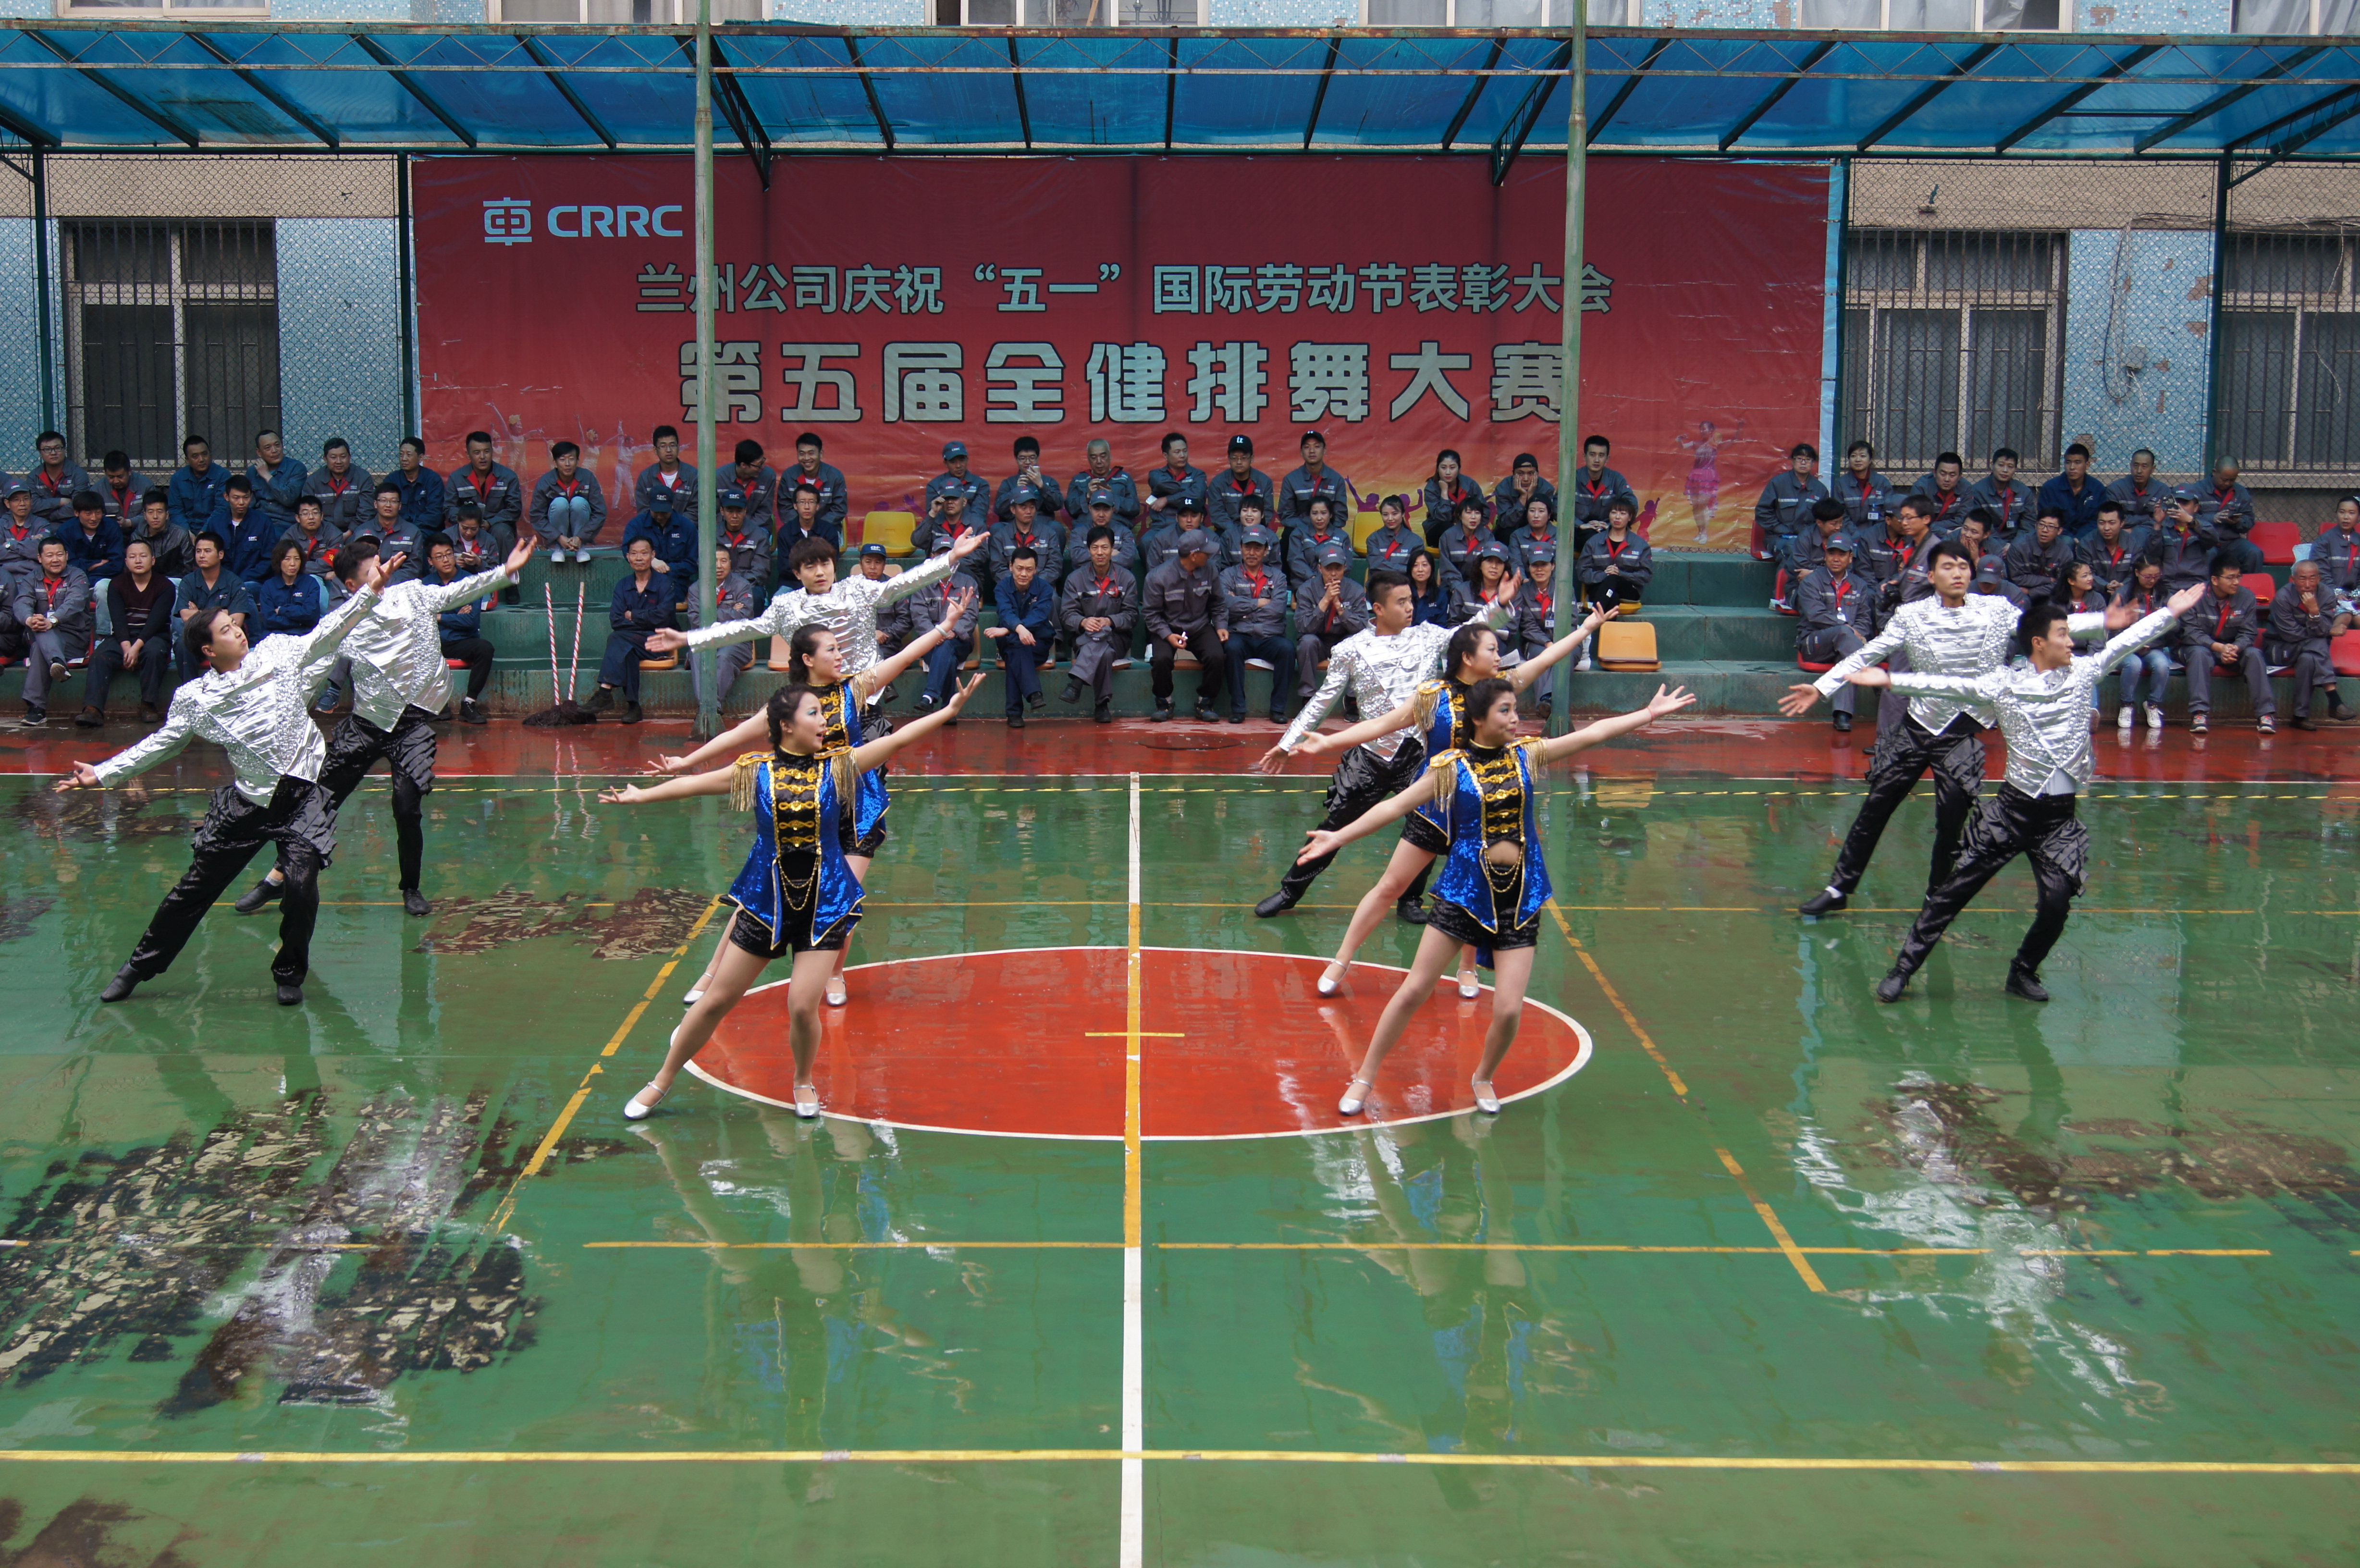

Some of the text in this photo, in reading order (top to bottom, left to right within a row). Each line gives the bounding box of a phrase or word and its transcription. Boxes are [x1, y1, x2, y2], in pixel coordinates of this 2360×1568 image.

[548, 205, 683, 237] CRRC
[637, 263, 944, 314] 兰州公司庆祝
[1154, 262, 1614, 314] 国际劳动节表彰大会
[679, 340, 1561, 423] 第五届全健排舞大赛
